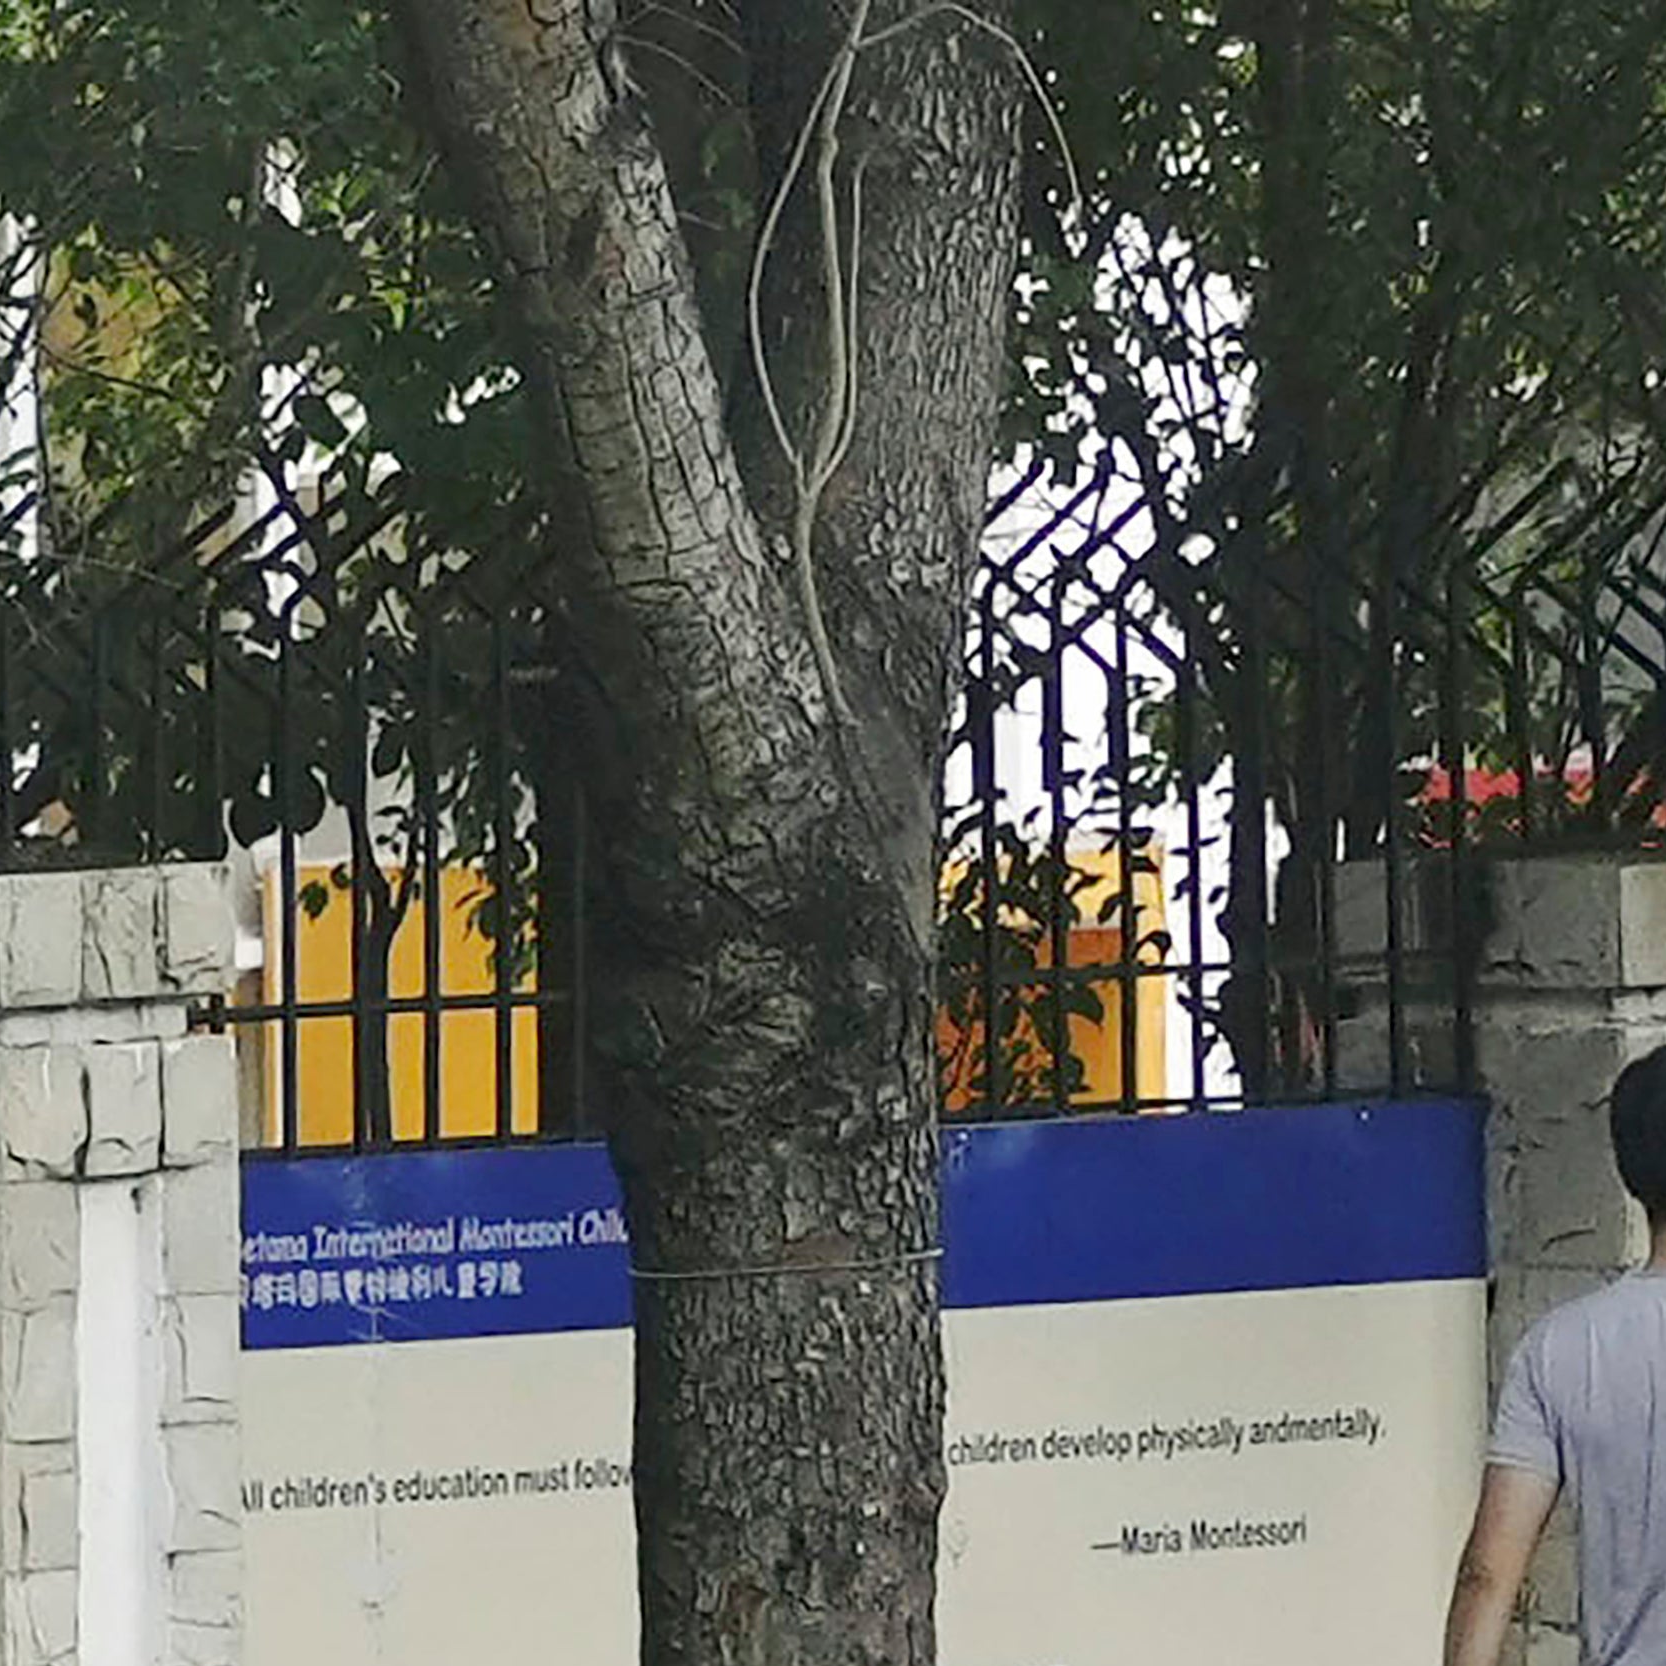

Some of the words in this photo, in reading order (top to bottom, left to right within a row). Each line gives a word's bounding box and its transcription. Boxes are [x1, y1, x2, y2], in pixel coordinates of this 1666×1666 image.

[947, 1432, 1036, 1466] children
[1041, 1424, 1132, 1463] develop
[1136, 1415, 1245, 1461] physically
[271, 1473, 387, 1511] children's
[392, 1469, 509, 1502] education
[515, 1462, 570, 1494] must
[1189, 1514, 1307, 1552] Montessori
